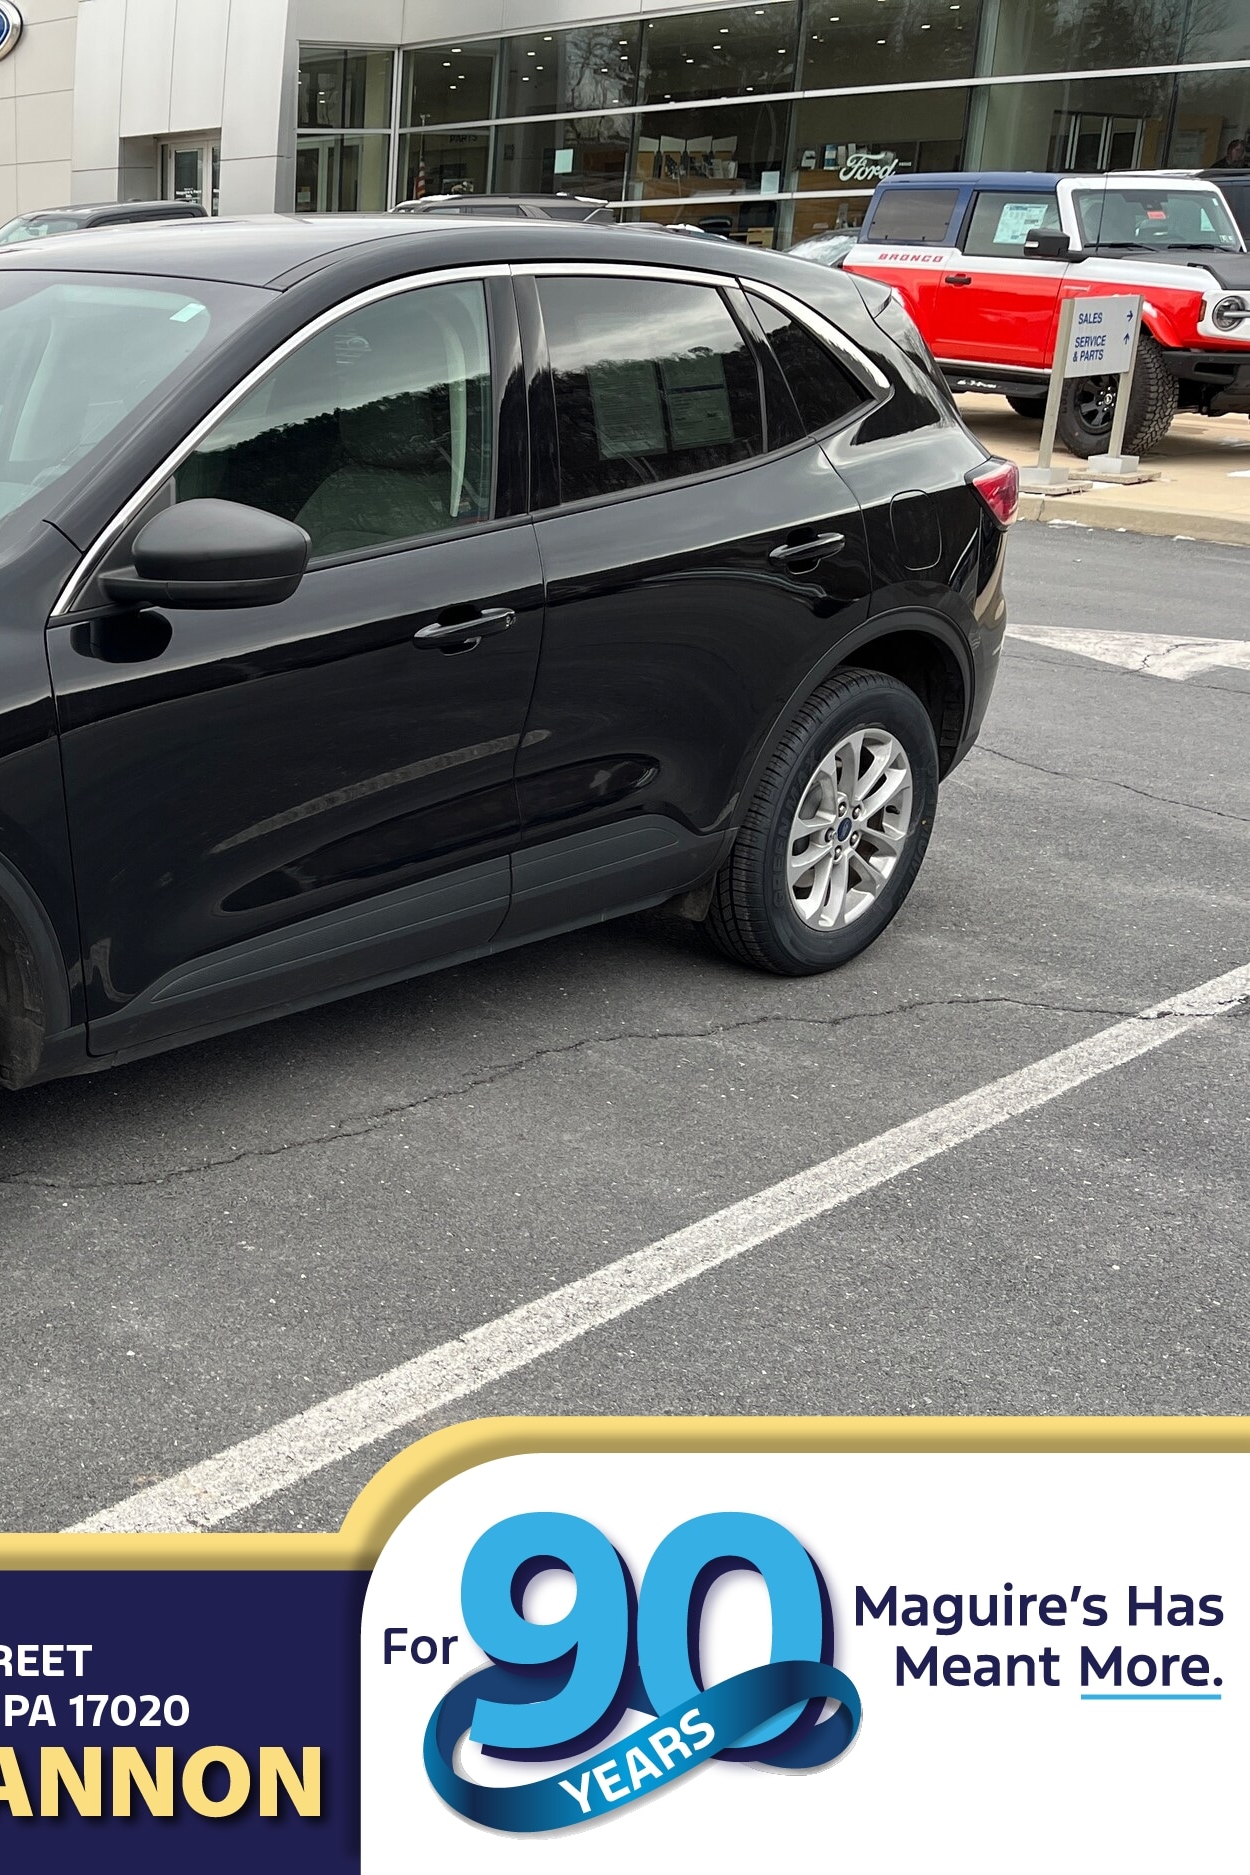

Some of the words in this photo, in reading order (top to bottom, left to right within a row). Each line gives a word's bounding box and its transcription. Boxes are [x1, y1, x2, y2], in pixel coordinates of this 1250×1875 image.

[839, 153, 899, 181] Ford
[878, 253, 944, 263] BRONCO
[1078, 312, 1103, 325] SALES
[1075, 335, 1106, 348] SERVICE
[1072, 351, 1078, 362] &
[1080, 349, 1104, 362] PARTS
